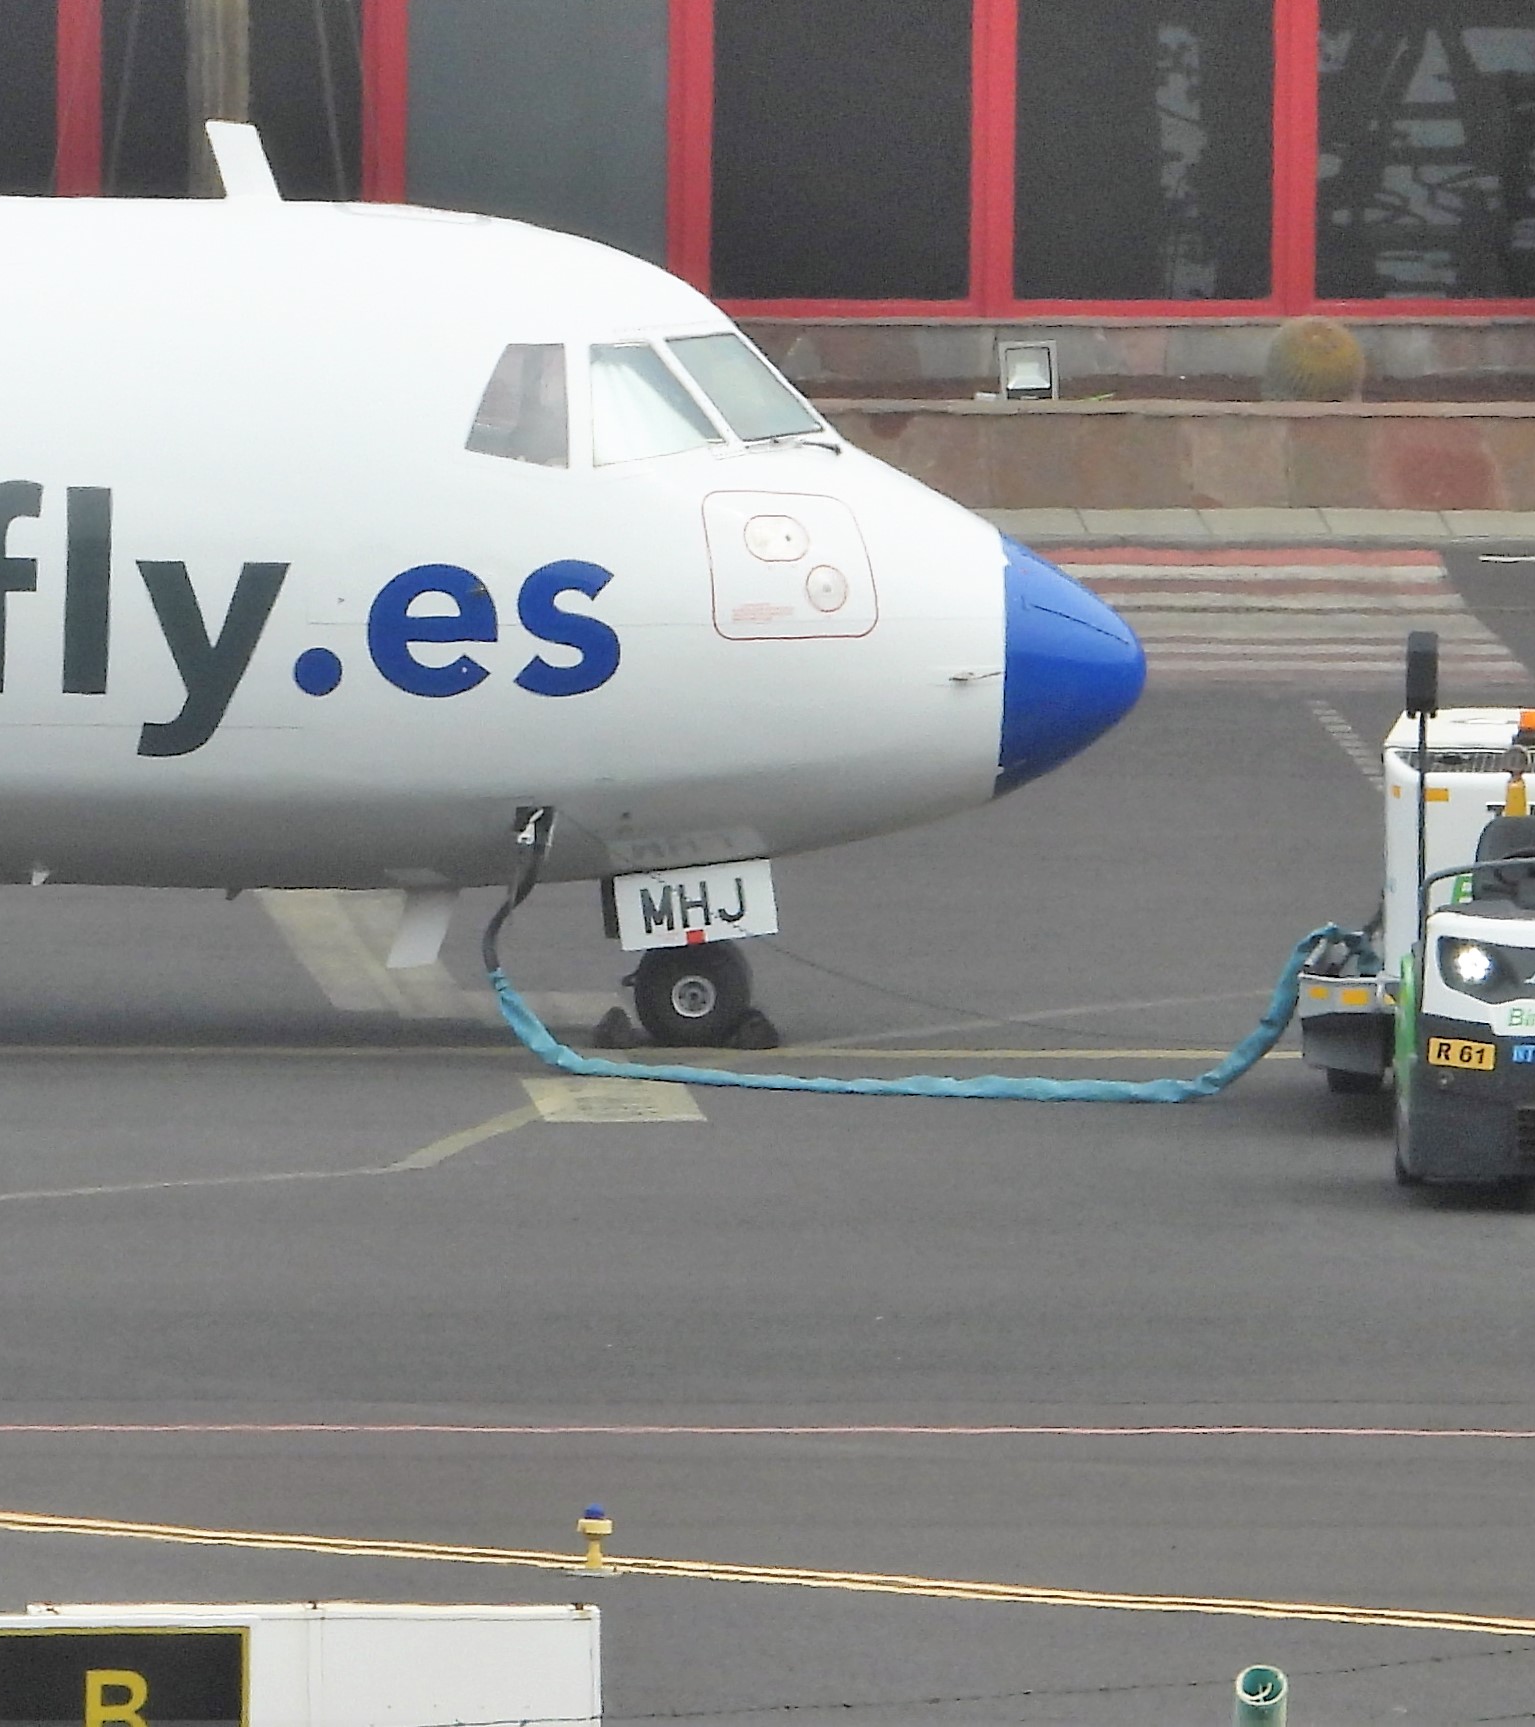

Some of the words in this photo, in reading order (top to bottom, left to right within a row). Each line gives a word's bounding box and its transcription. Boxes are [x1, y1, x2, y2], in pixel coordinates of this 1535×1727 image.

[640, 878, 745, 933] MHJ
[1437, 1042, 1451, 1061] R
[1459, 1045, 1485, 1064] 61
[84, 1669, 149, 1727] B
